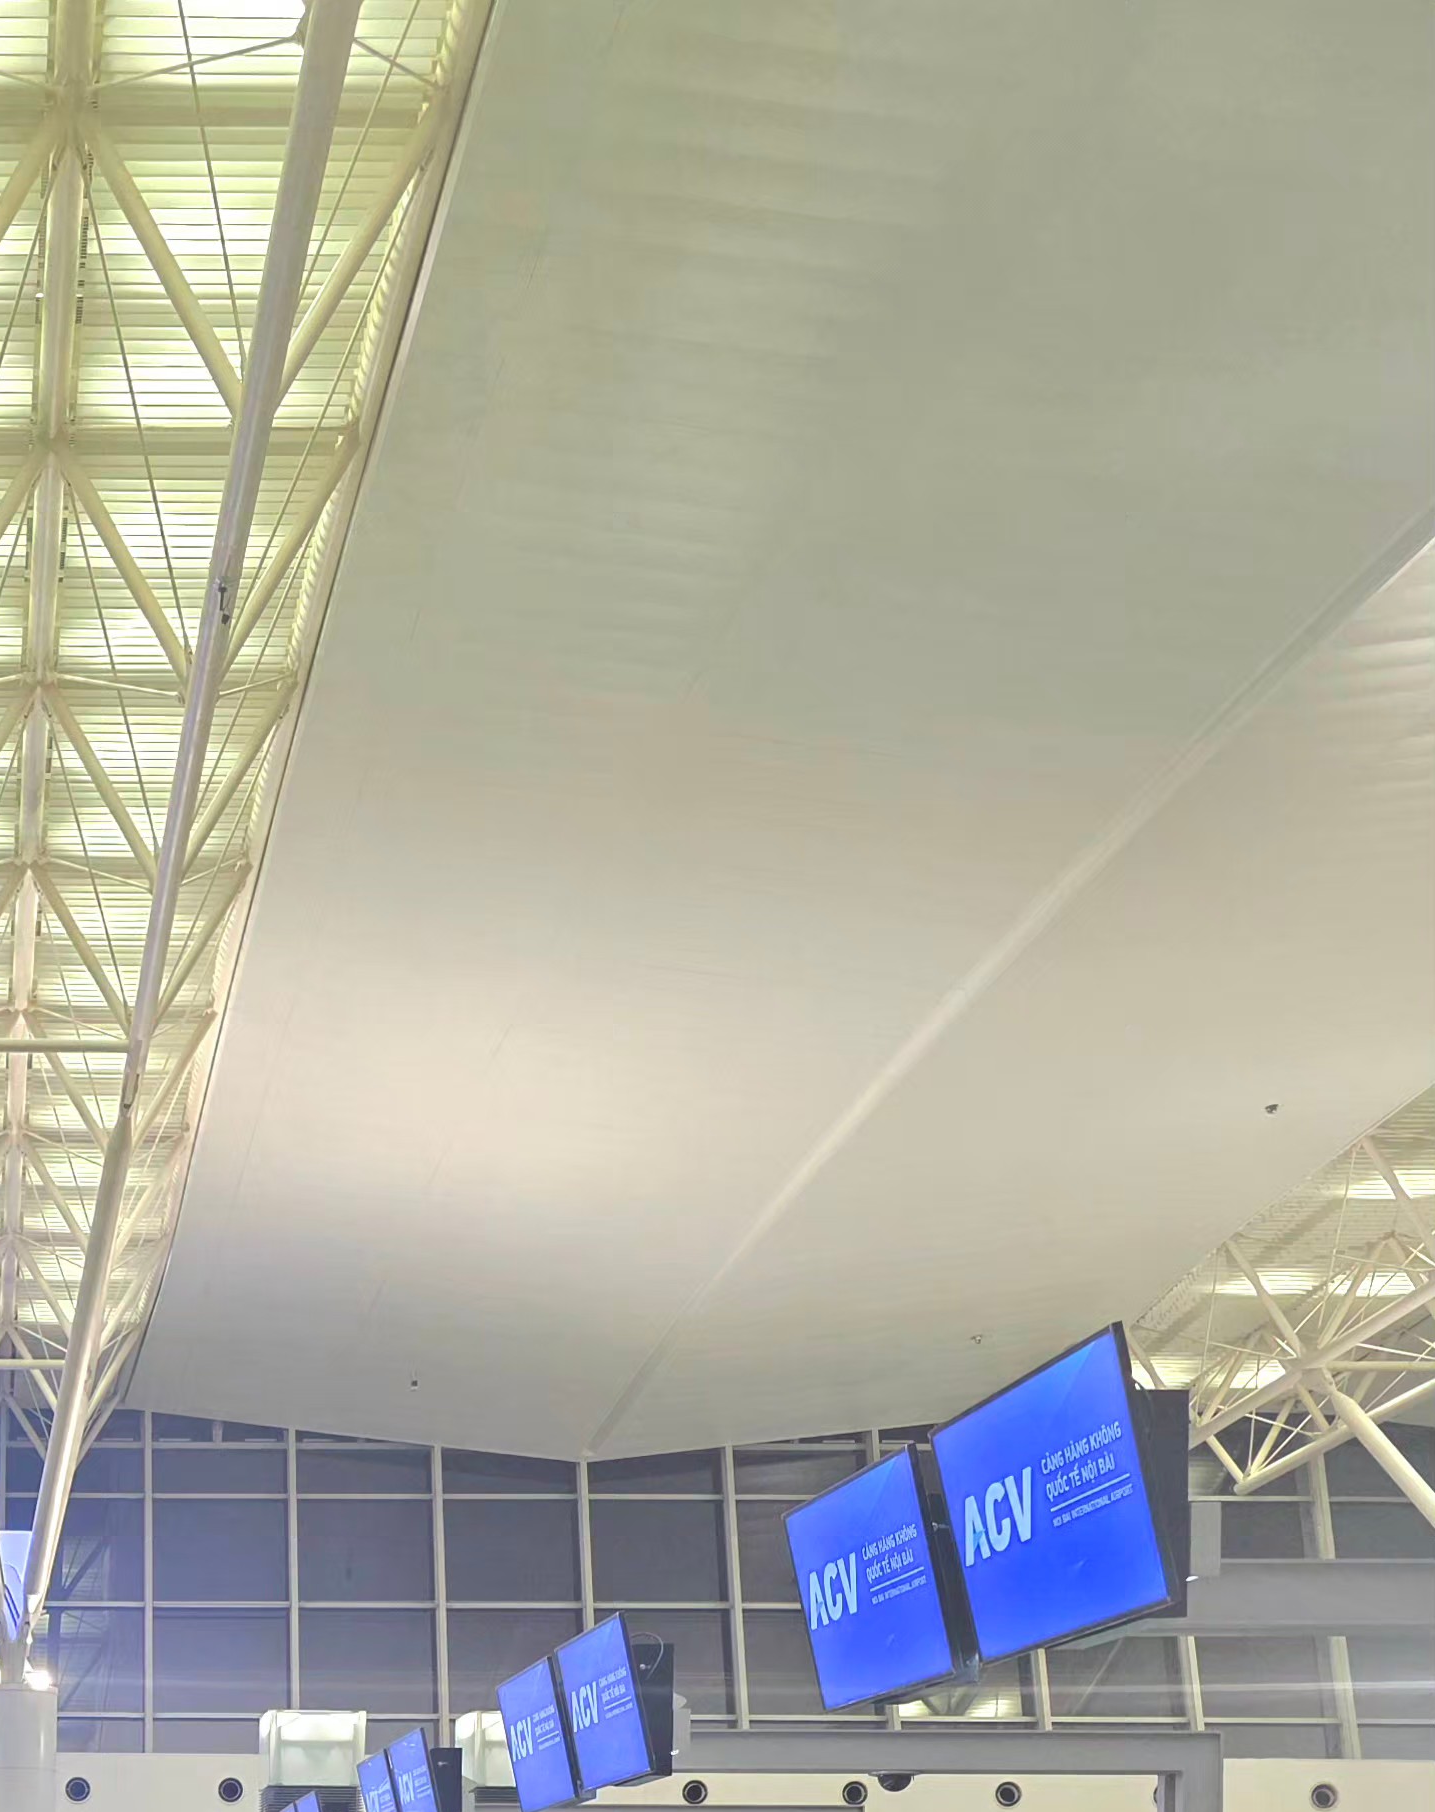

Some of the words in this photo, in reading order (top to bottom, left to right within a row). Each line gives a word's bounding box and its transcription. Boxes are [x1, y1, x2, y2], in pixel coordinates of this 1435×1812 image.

[1064, 1440, 1089, 1463] HÀNG
[1089, 1421, 1122, 1450] KHÔNG
[1099, 1451, 1115, 1474] BÀI
[965, 1466, 1032, 1567] ACV
[809, 1552, 858, 1630] ACV
[571, 1680, 599, 1733] ACV
[509, 1716, 534, 1763] ACV
